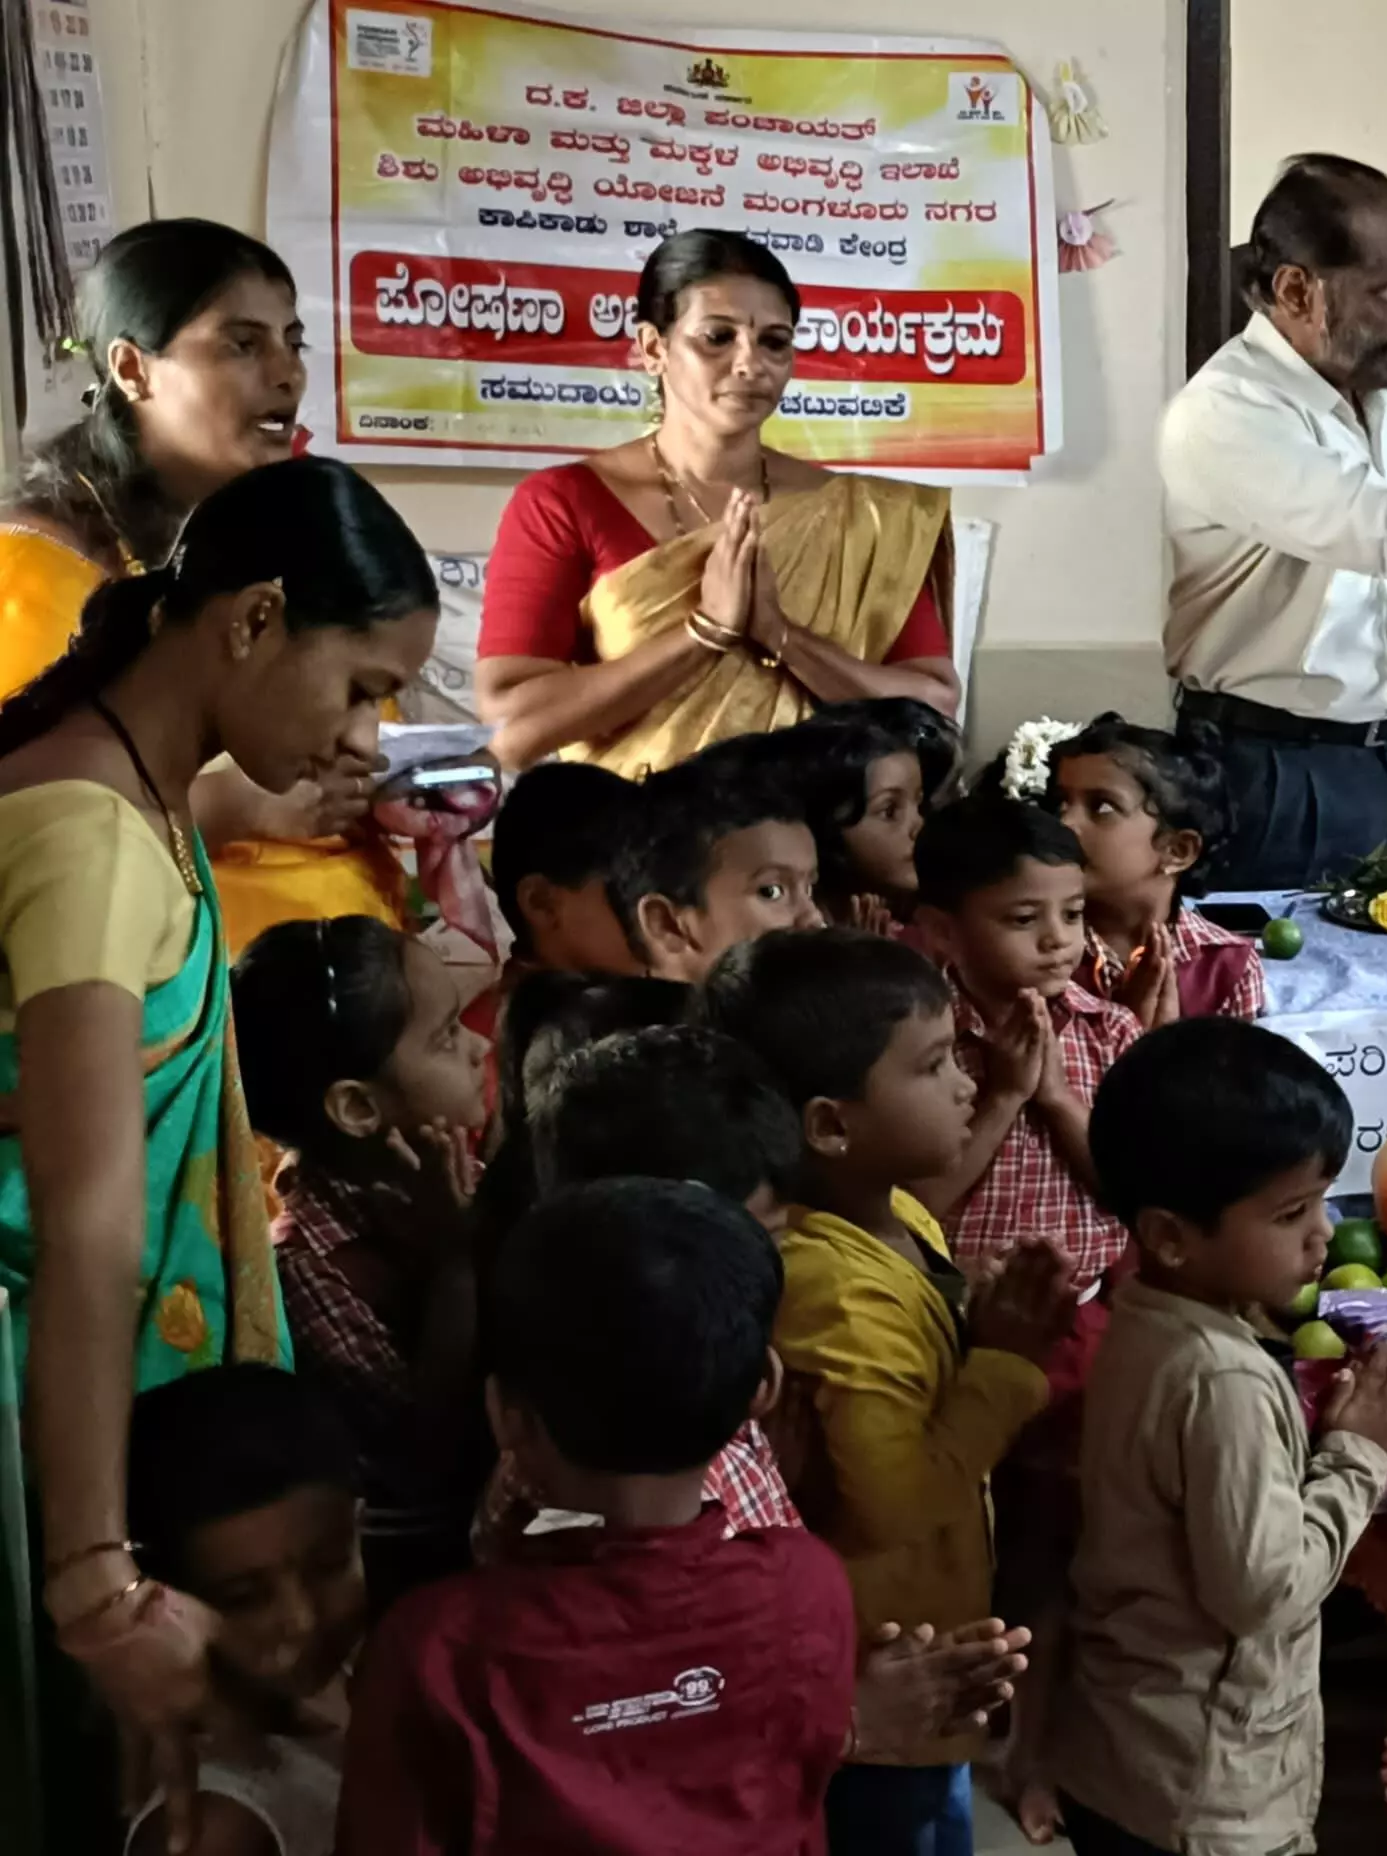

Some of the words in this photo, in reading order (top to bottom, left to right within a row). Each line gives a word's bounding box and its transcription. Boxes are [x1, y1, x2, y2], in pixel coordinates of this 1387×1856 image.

[617, 96, 686, 126] ಜಿಲ್ಲಾ
[705, 109, 876, 140] ಪಂಚಾಯತ್
[417, 115, 530, 145] ಮಹಿಳಾ
[550, 128, 631, 163] ಮತ್ತು
[650, 136, 739, 175] ಮಕ್ಕಳ
[757, 152, 863, 192] ಅಭಿವೃದ್ಧಿ
[879, 157, 960, 181] ಇಲಾಖೆ
[377, 153, 439, 181] ಶಿಶು
[458, 165, 573, 205] ಅಭಿವೃದ್ಧಿ
[594, 174, 725, 209] ಯೋಜನೆ
[743, 192, 908, 221] ಮಂಗಳೂರು
[924, 199, 997, 223] ನಗರ
[478, 208, 608, 235] ಕಾಪಿಕಾಡು
[839, 233, 907, 265] ಕೇಂದ್ರ
[376, 263, 565, 341] ಪೋಷಣಾ
[793, 296, 1004, 375] ಕಾರ್ಯಕ್ರಮ
[359, 414, 435, 433] ದಿನಾಂಕ:
[480, 377, 642, 406] ಸಮುದಾಯ
[780, 391, 906, 416] ಚಟುವಟಿಕೆ
